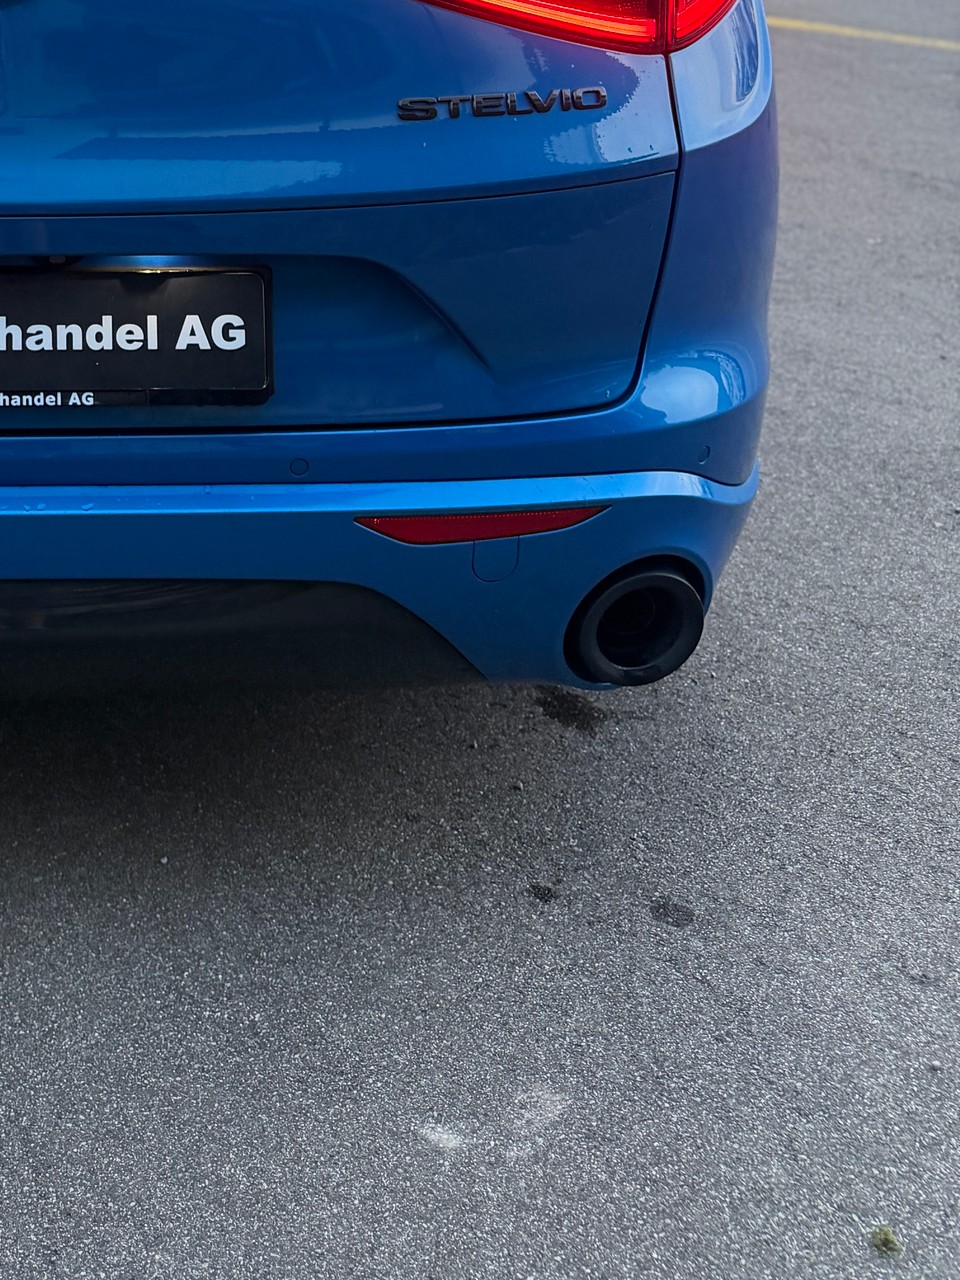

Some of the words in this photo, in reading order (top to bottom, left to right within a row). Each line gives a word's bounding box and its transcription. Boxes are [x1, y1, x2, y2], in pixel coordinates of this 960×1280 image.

[397, 86, 607, 121] STELVIO
[175, 314, 246, 351] AG
[68, 391, 94, 406] AG
